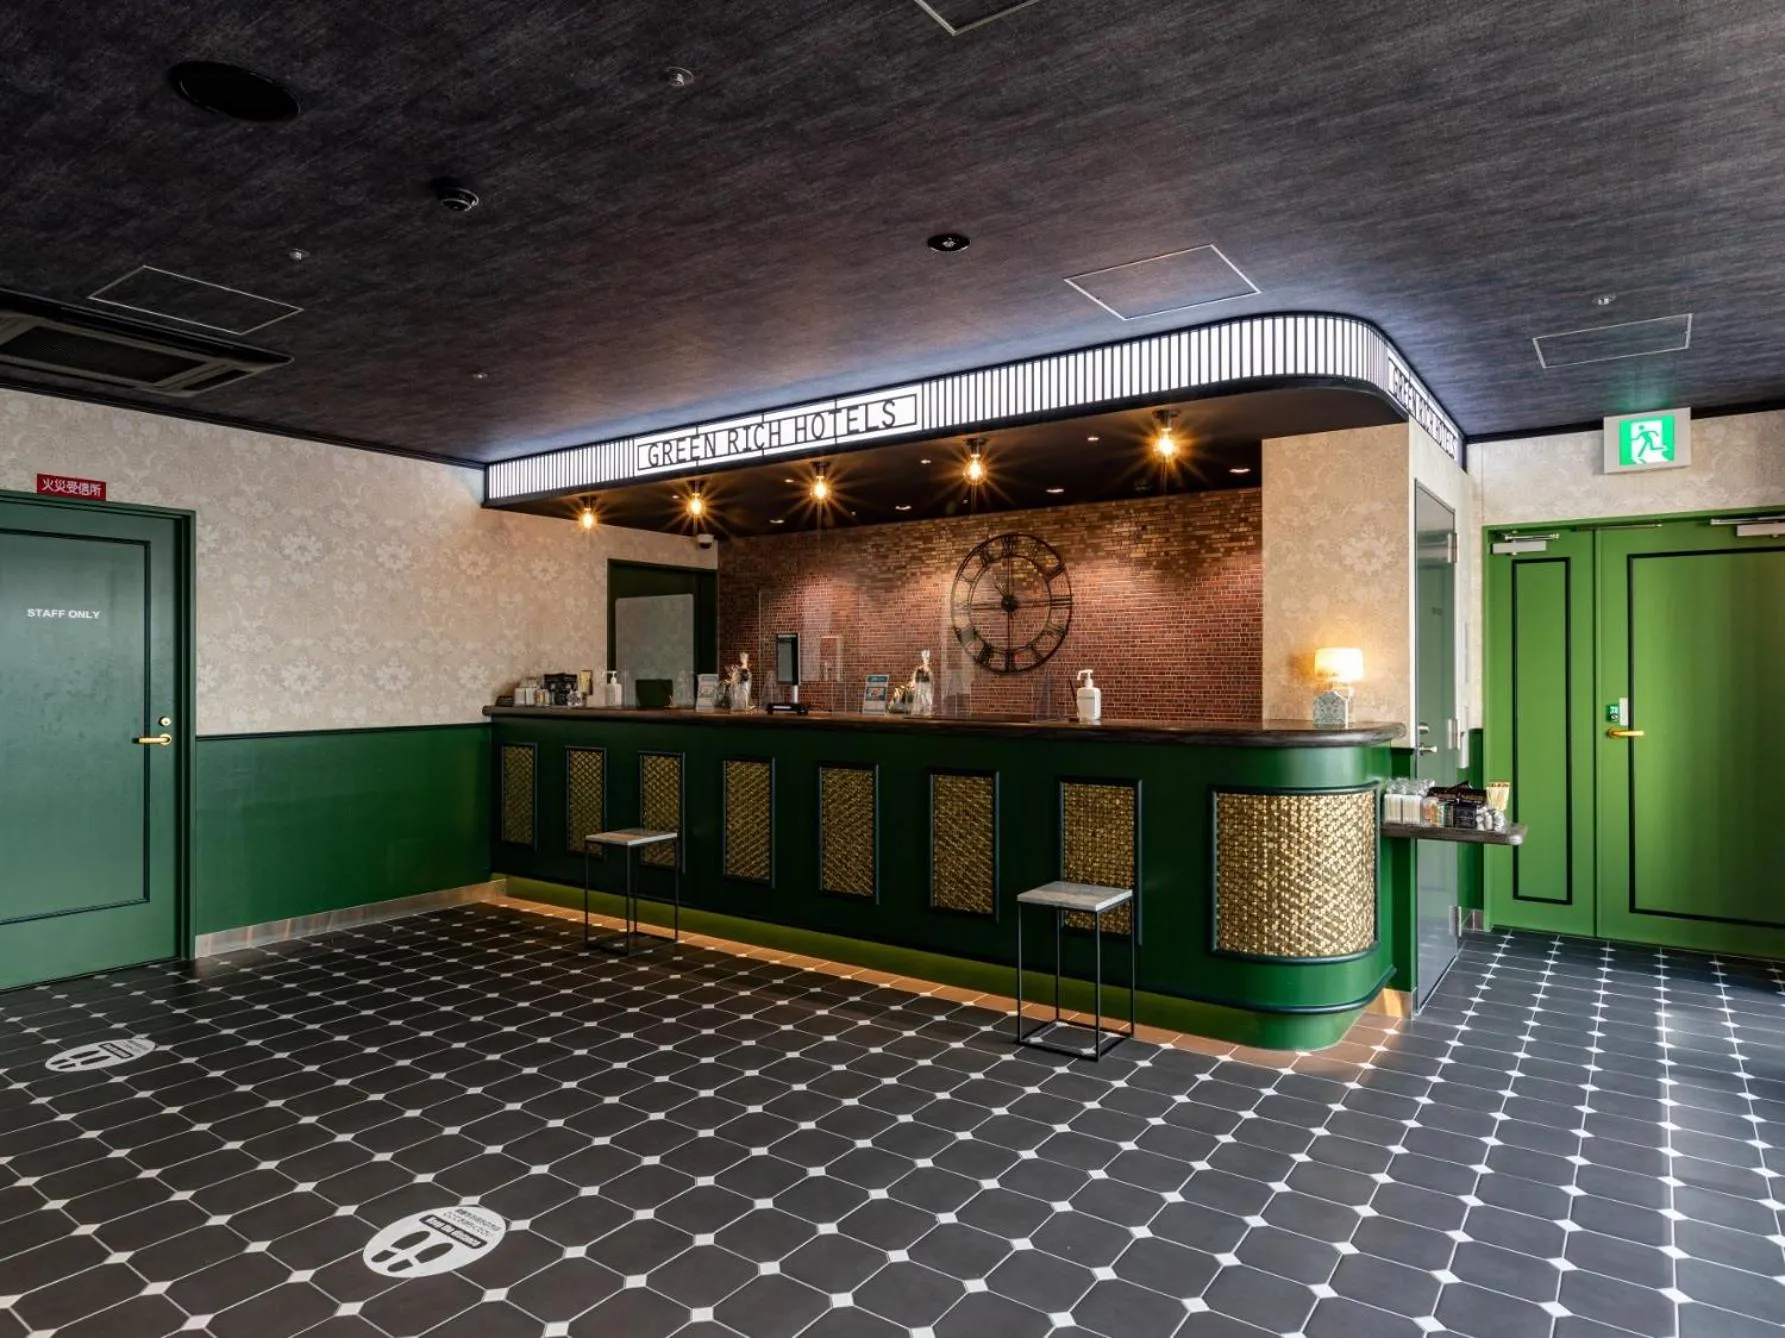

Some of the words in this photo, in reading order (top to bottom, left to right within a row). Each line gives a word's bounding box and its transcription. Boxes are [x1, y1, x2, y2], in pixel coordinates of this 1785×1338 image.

[648, 432, 716, 468] GREEN
[728, 419, 781, 452] RICH
[795, 401, 896, 442] HOTELS
[42, 478, 101, 497] 火災受信所
[27, 608, 65, 619] STAFF
[68, 609, 101, 619] ONLY
